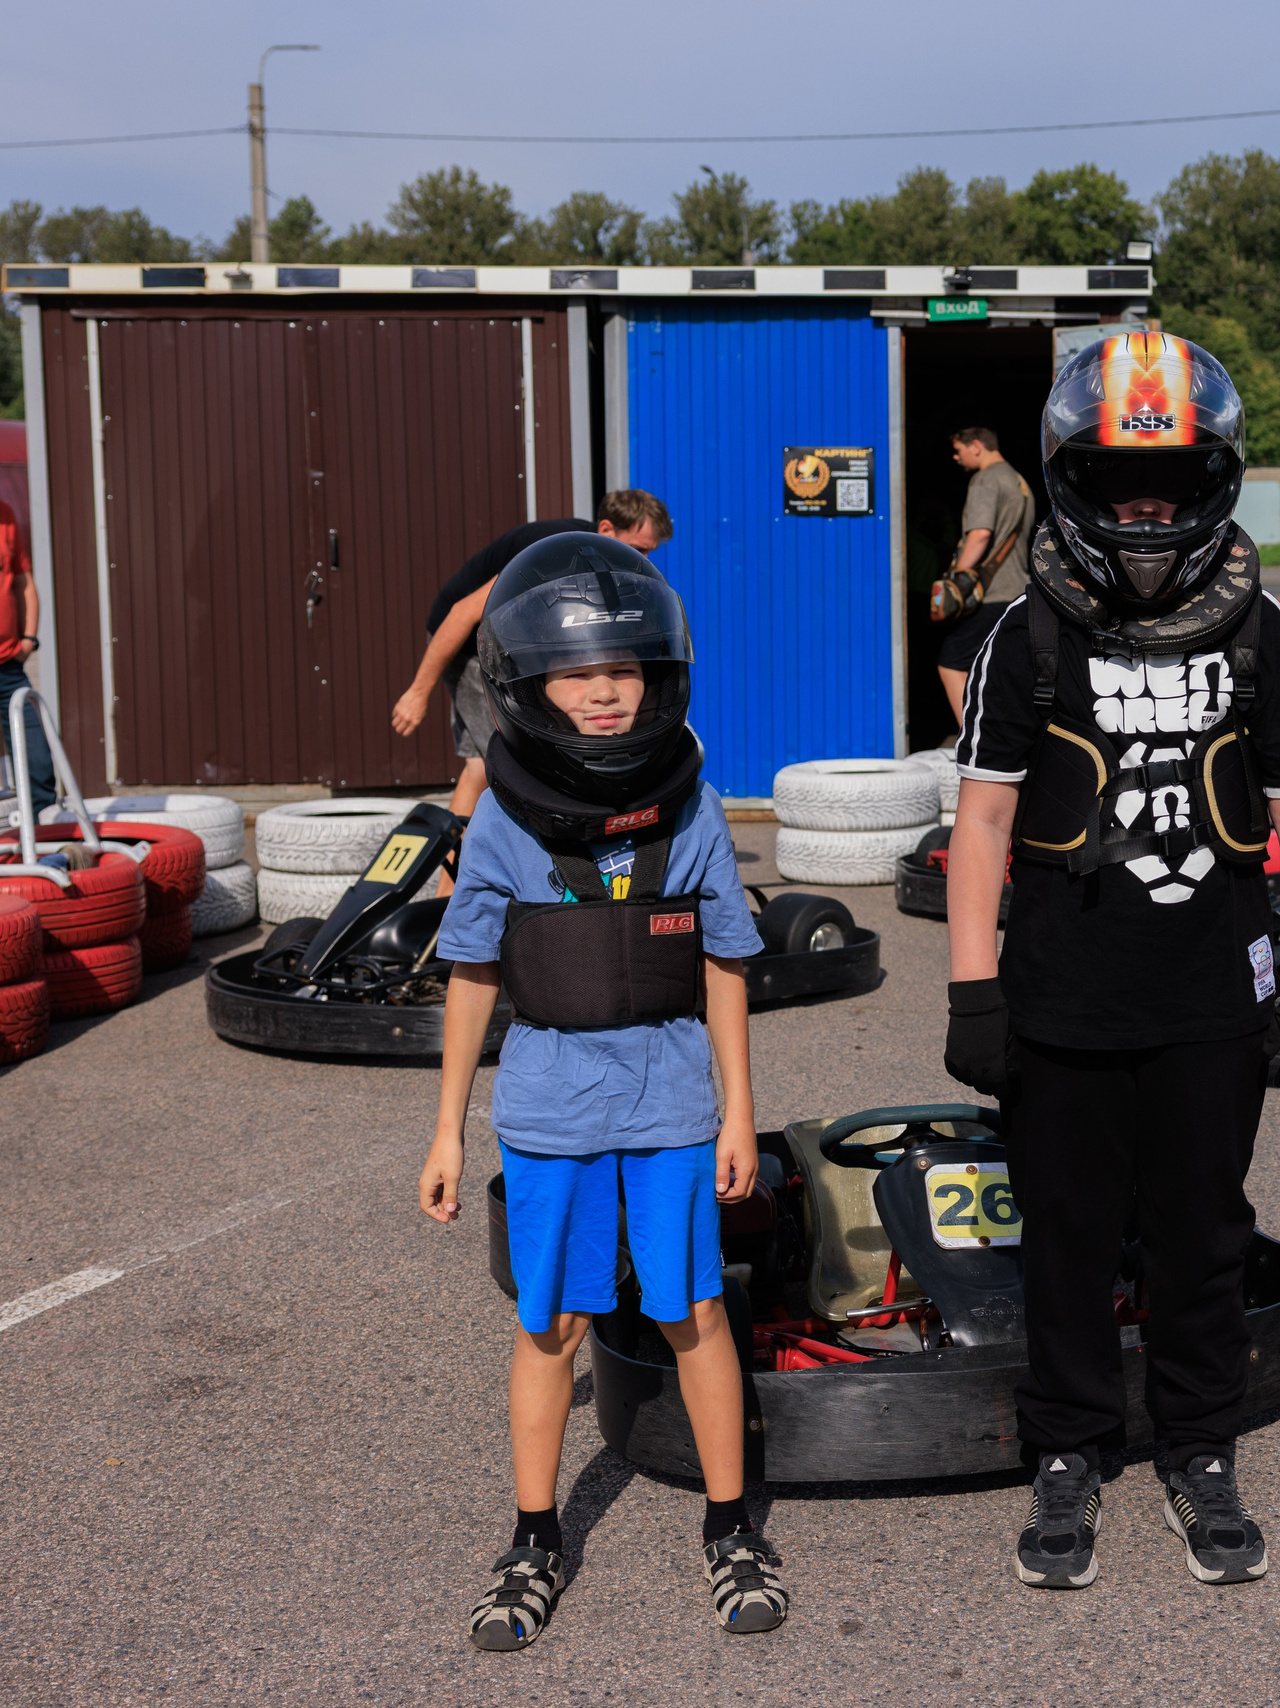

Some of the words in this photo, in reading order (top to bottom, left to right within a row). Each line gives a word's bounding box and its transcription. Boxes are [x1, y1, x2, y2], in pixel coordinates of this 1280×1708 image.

[936, 301, 980, 315] ВХОД
[814, 449, 869, 458] КАРТИНГ
[561, 610, 644, 628] LS2
[1088, 653, 1188, 699] WE
[1093, 696, 1189, 735] ARE
[1201, 714, 1218, 725] FIFA
[610, 810, 655, 828] RLG
[384, 846, 411, 871] 11
[655, 917, 690, 931] RLG
[934, 1183, 1022, 1228] 26
